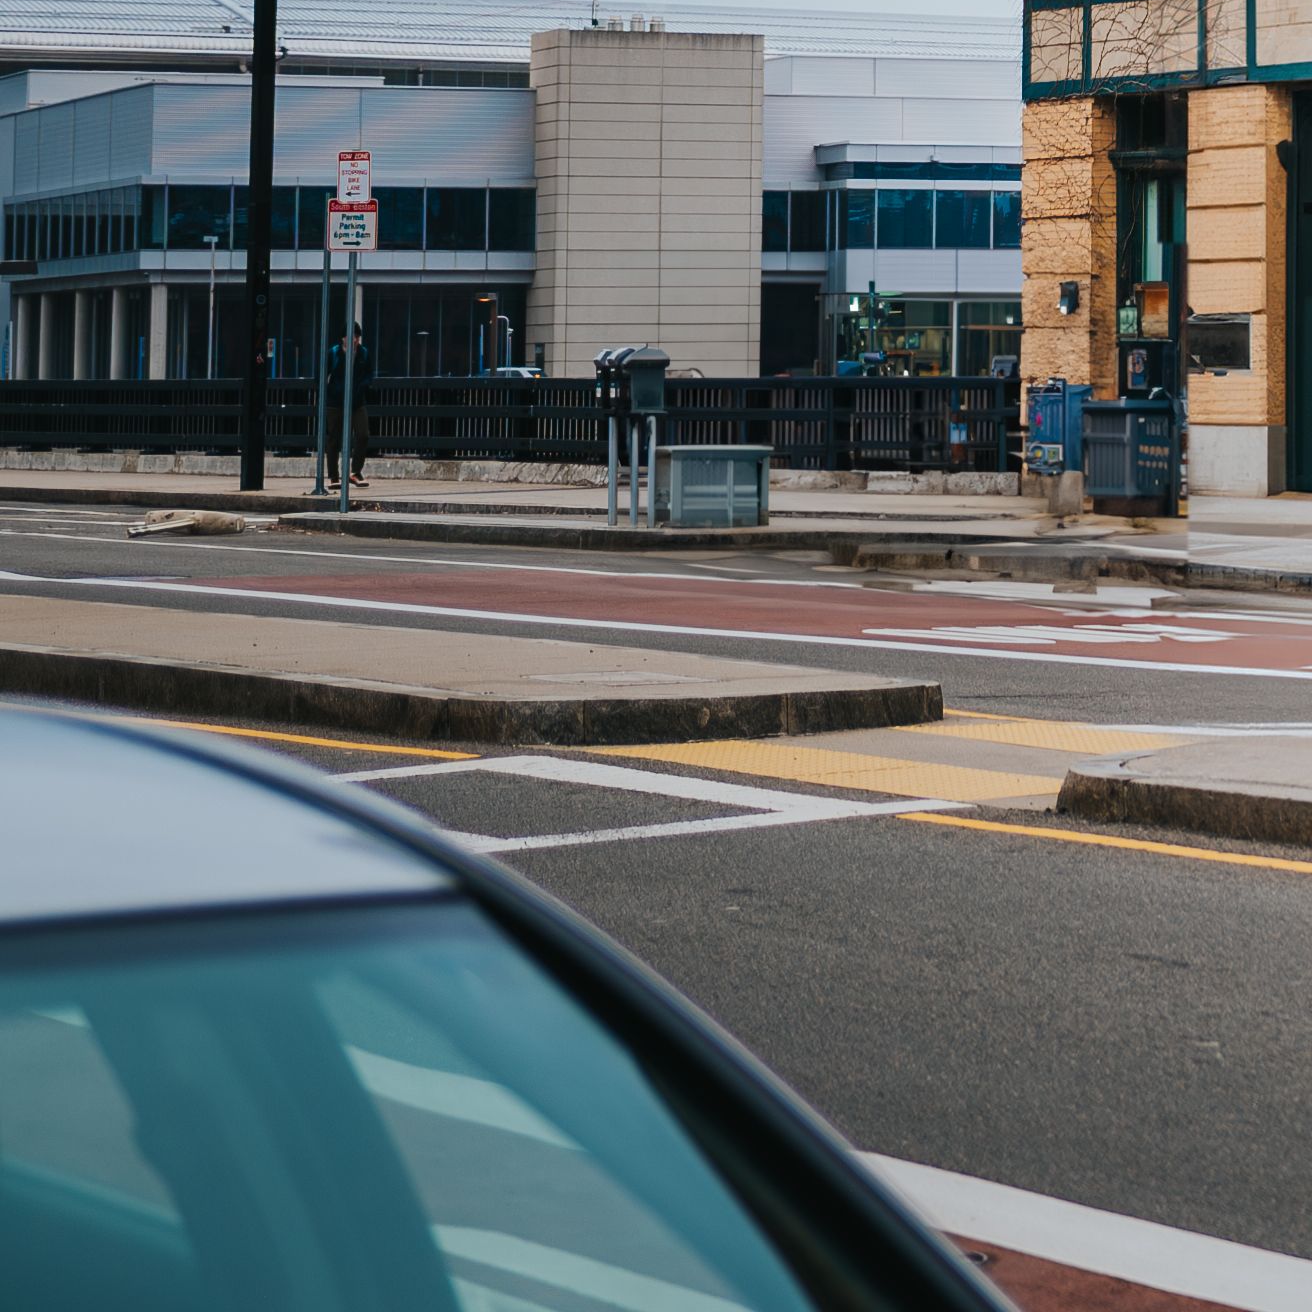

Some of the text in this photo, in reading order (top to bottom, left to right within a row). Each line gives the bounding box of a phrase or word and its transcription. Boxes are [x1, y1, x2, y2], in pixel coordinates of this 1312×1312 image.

[341, 213, 365, 221] Permit
[339, 223, 366, 231] Parking
[355, 231, 371, 239] 8am
